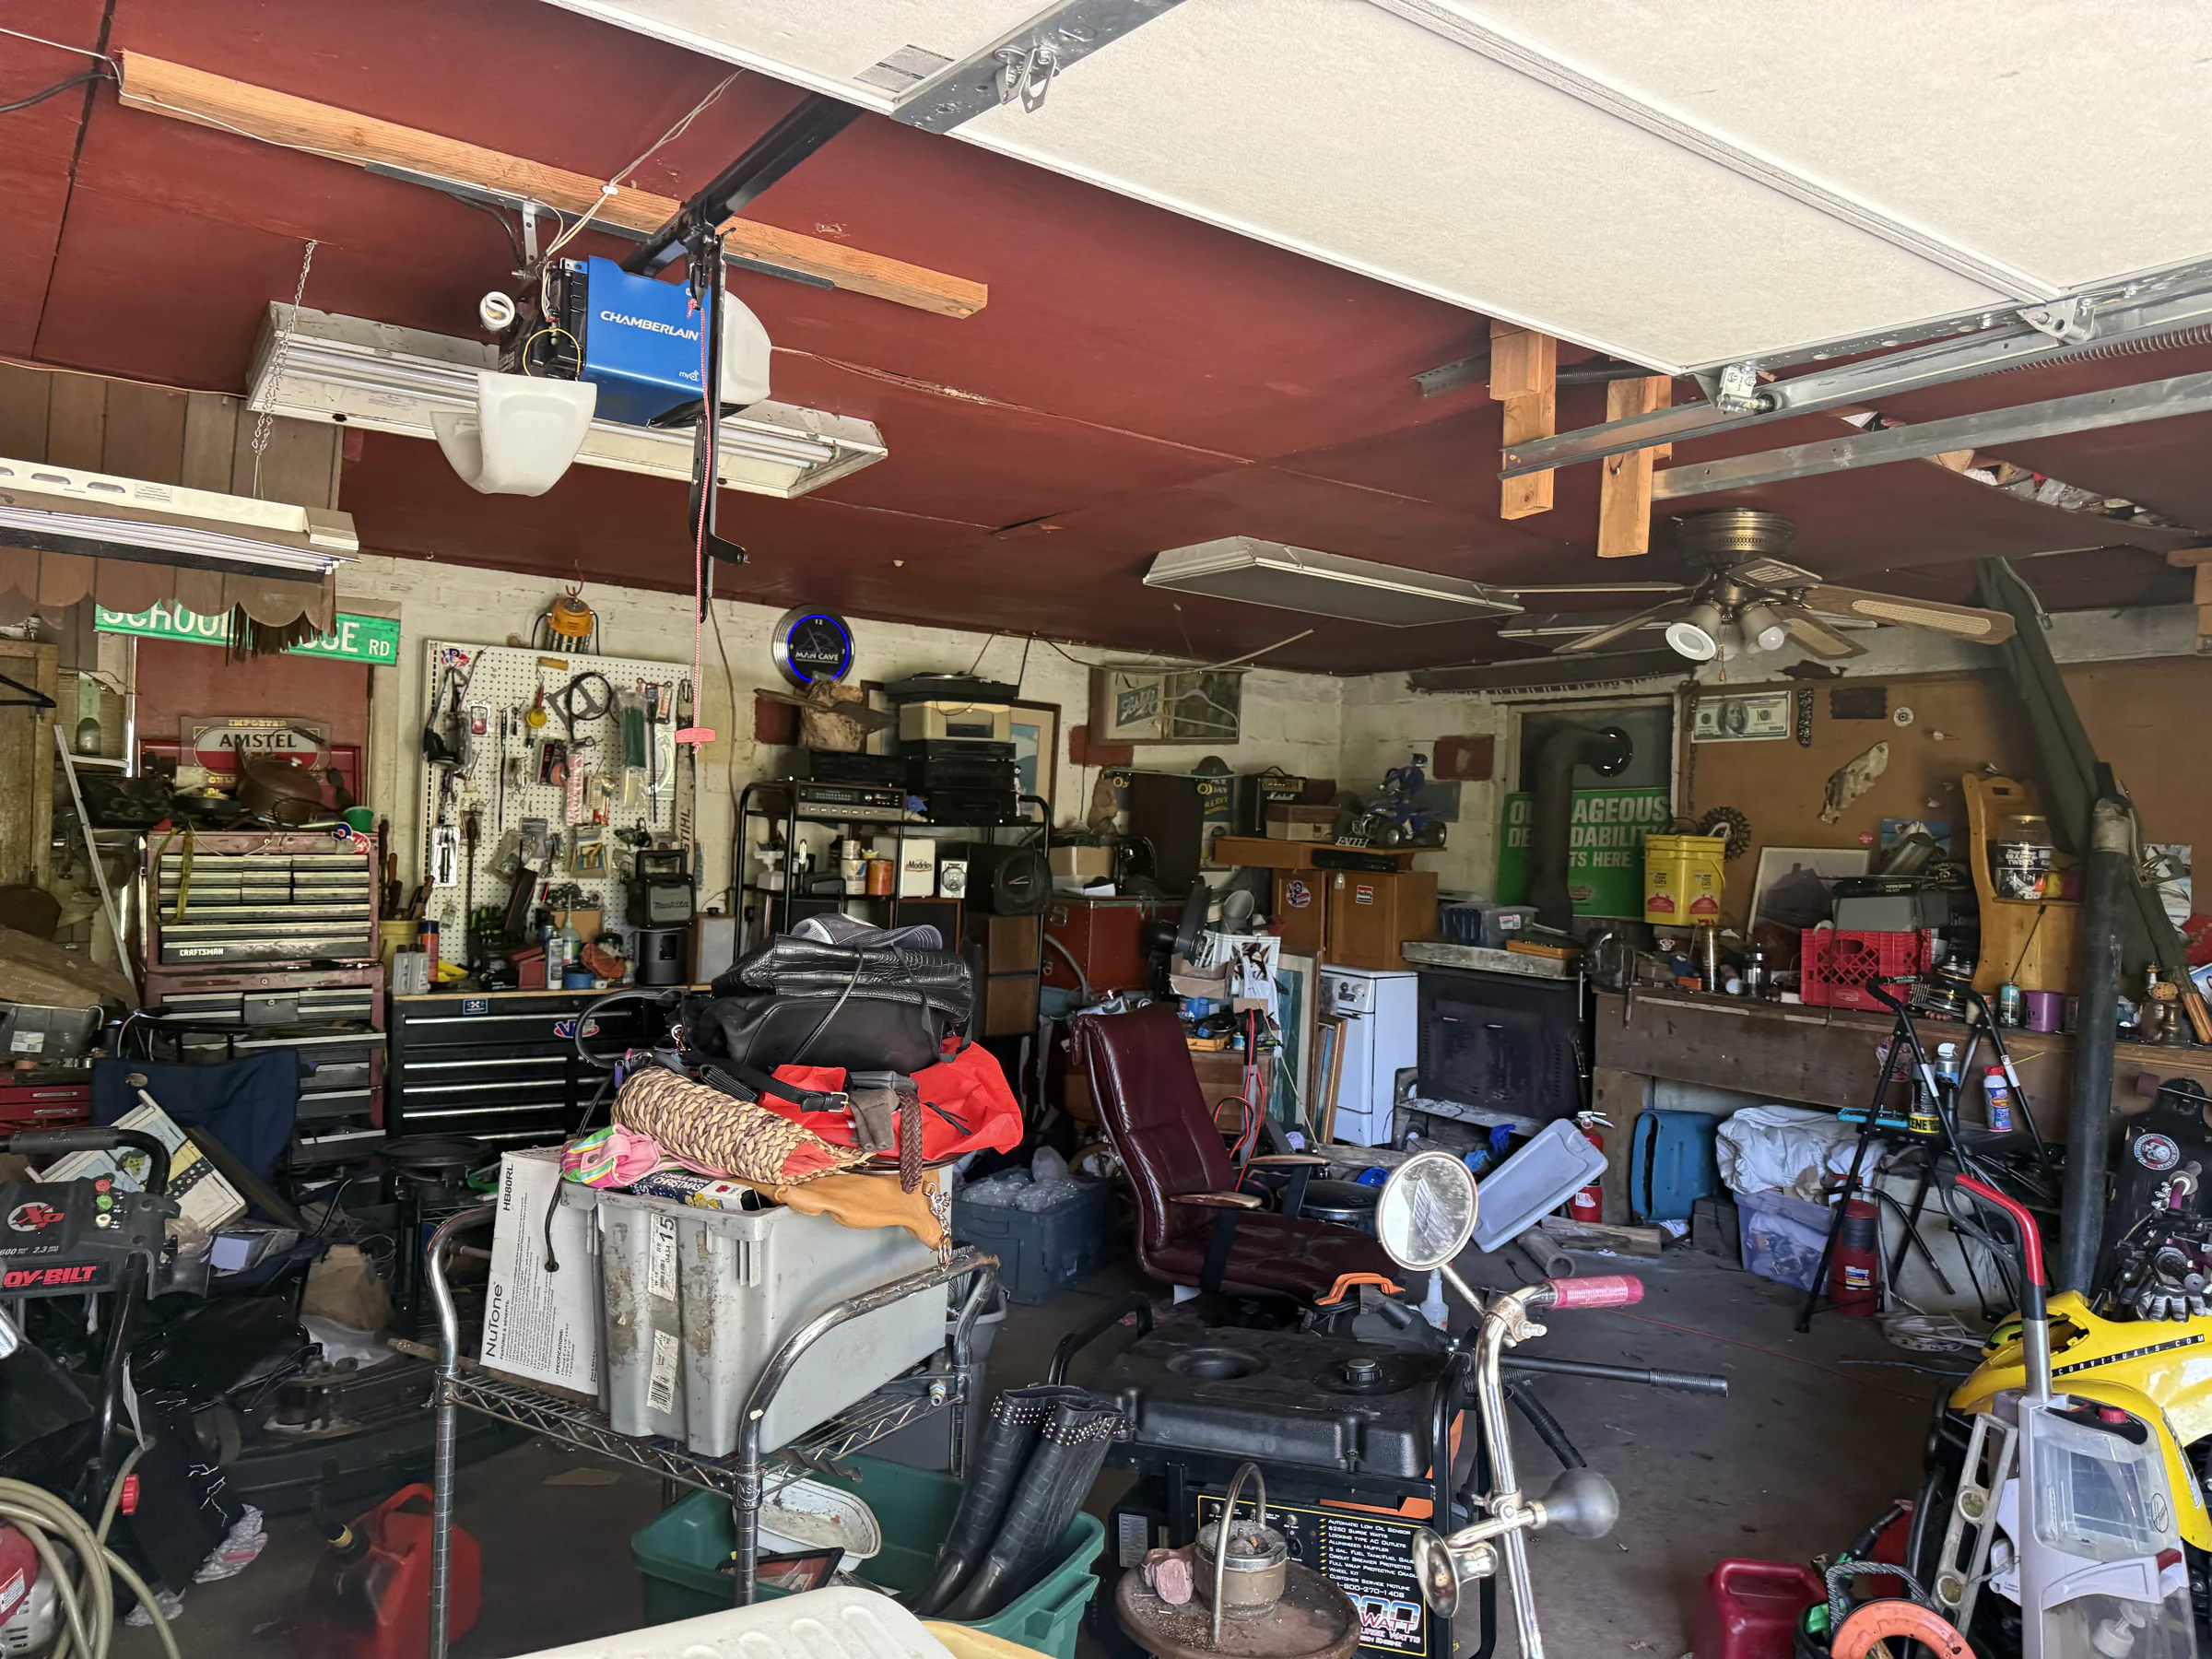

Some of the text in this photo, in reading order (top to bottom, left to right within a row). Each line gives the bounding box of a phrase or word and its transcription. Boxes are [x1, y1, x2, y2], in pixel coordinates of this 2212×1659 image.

[600, 311, 700, 341] CHAMBERLAIN
[369, 639, 390, 656] RD
[818, 653, 839, 661] CAVE
[219, 734, 296, 748] AMSTEL
[179, 948, 224, 956] CRAFTSMAN
[503, 1163, 513, 1212] HB80RL
[653, 1177, 704, 1191] CHRISTMAS
[659, 1217, 674, 1242] 15
[32, 1246, 48, 1254] 2.3
[0, 1266, 97, 1288] OY-BILT
[485, 1284, 503, 1357] NuTone
[555, 1329, 564, 1375] SPECIFICATIONS:
[2050, 1334, 2204, 1376] CORVISUALS.COM
[1328, 1519, 1359, 1528] AUTOMATIC
[1329, 1540, 1389, 1553] ALUMINIZED MUFFLER
[1381, 1540, 1406, 1548] OUTLETS
[1352, 1557, 1377, 1565] BREAKER
[1379, 1561, 1412, 1570] PROTECTED
[1367, 1552, 1397, 1562] TANK/FUEL
[1363, 1565, 1396, 1575] PROTECTIVE
[1329, 1574, 1359, 1583] CUSTOMER
[1361, 1578, 1384, 1587] SERVICE
[1336, 1582, 1405, 1598] 1-800-270-1408
[1360, 1612, 1415, 1634] WATT
[1360, 1627, 1386, 1638] URGE
[1388, 1631, 1421, 1644] WATTS
